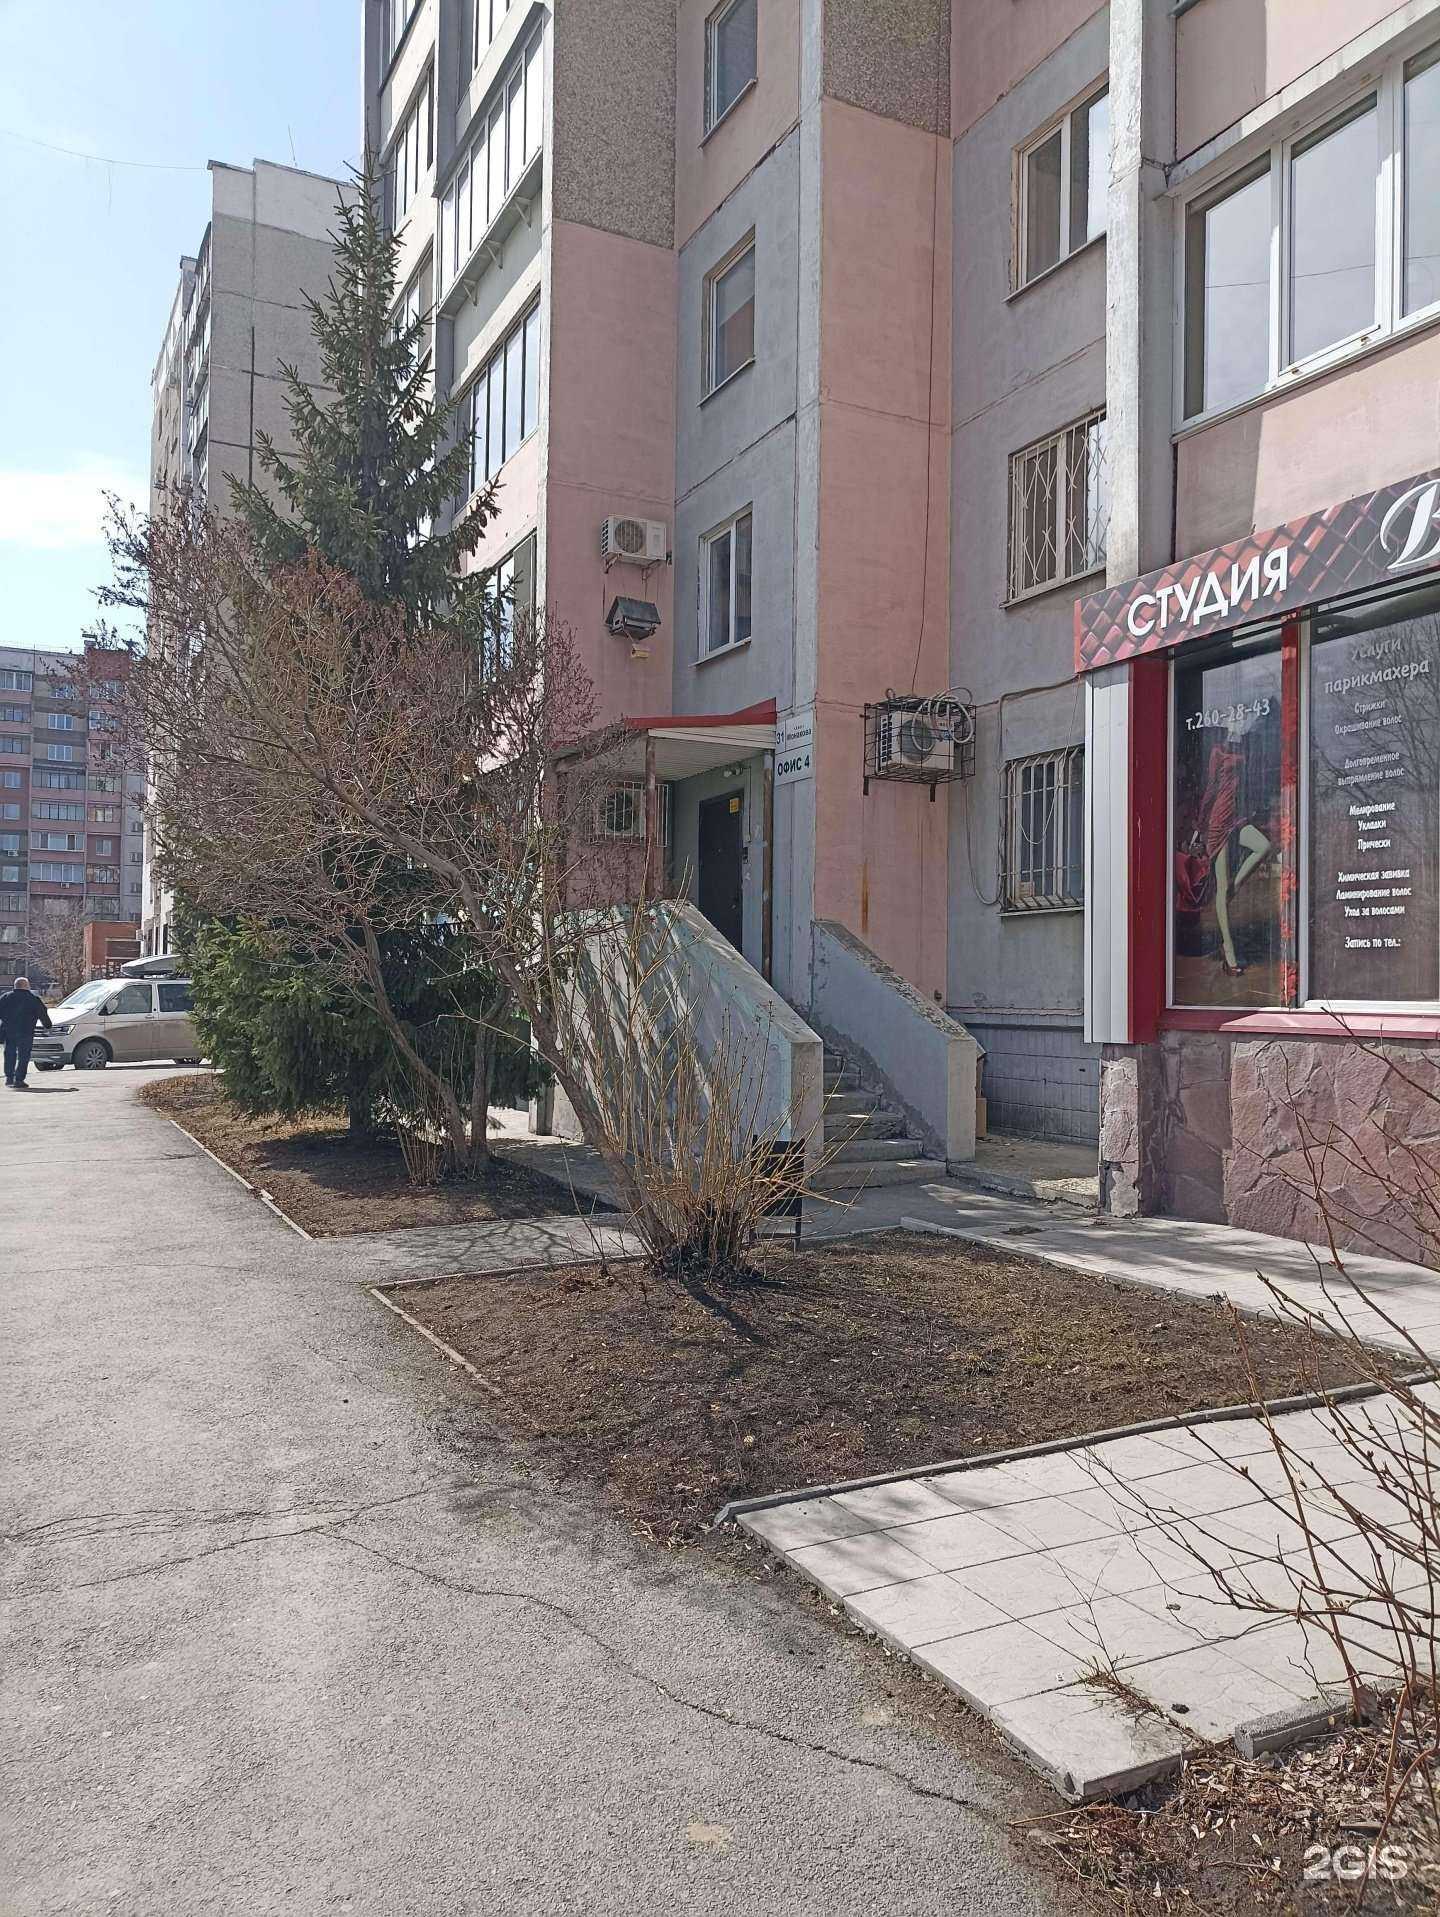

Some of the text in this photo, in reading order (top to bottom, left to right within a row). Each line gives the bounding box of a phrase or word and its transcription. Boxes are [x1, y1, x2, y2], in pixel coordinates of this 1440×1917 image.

[1127, 546, 1289, 636] СТУДИЯ
[1351, 638, 1401, 660] Услуги
[1324, 659, 1431, 695] парикмахера
[1354, 699, 1386, 715] Стрижки
[1334, 715, 1403, 736] Окрашивание волос
[777, 755, 810, 776] ОФИС 4
[1344, 751, 1400, 769] Долговременное
[1338, 766, 1405, 786] выпрямление волос
[1349, 801, 1396, 817] Мелирование
[1358, 819, 1387, 831] Укладки
[1357, 838, 1391, 852] Прически
[1337, 868, 1410, 883] Химическая завивка
[1336, 886, 1412, 901] Ламинирование волос
[1344, 905, 1405, 917] Уход за волосами
[1344, 936, 1371, 949] Запись
[1372, 938, 1382, 948] по
